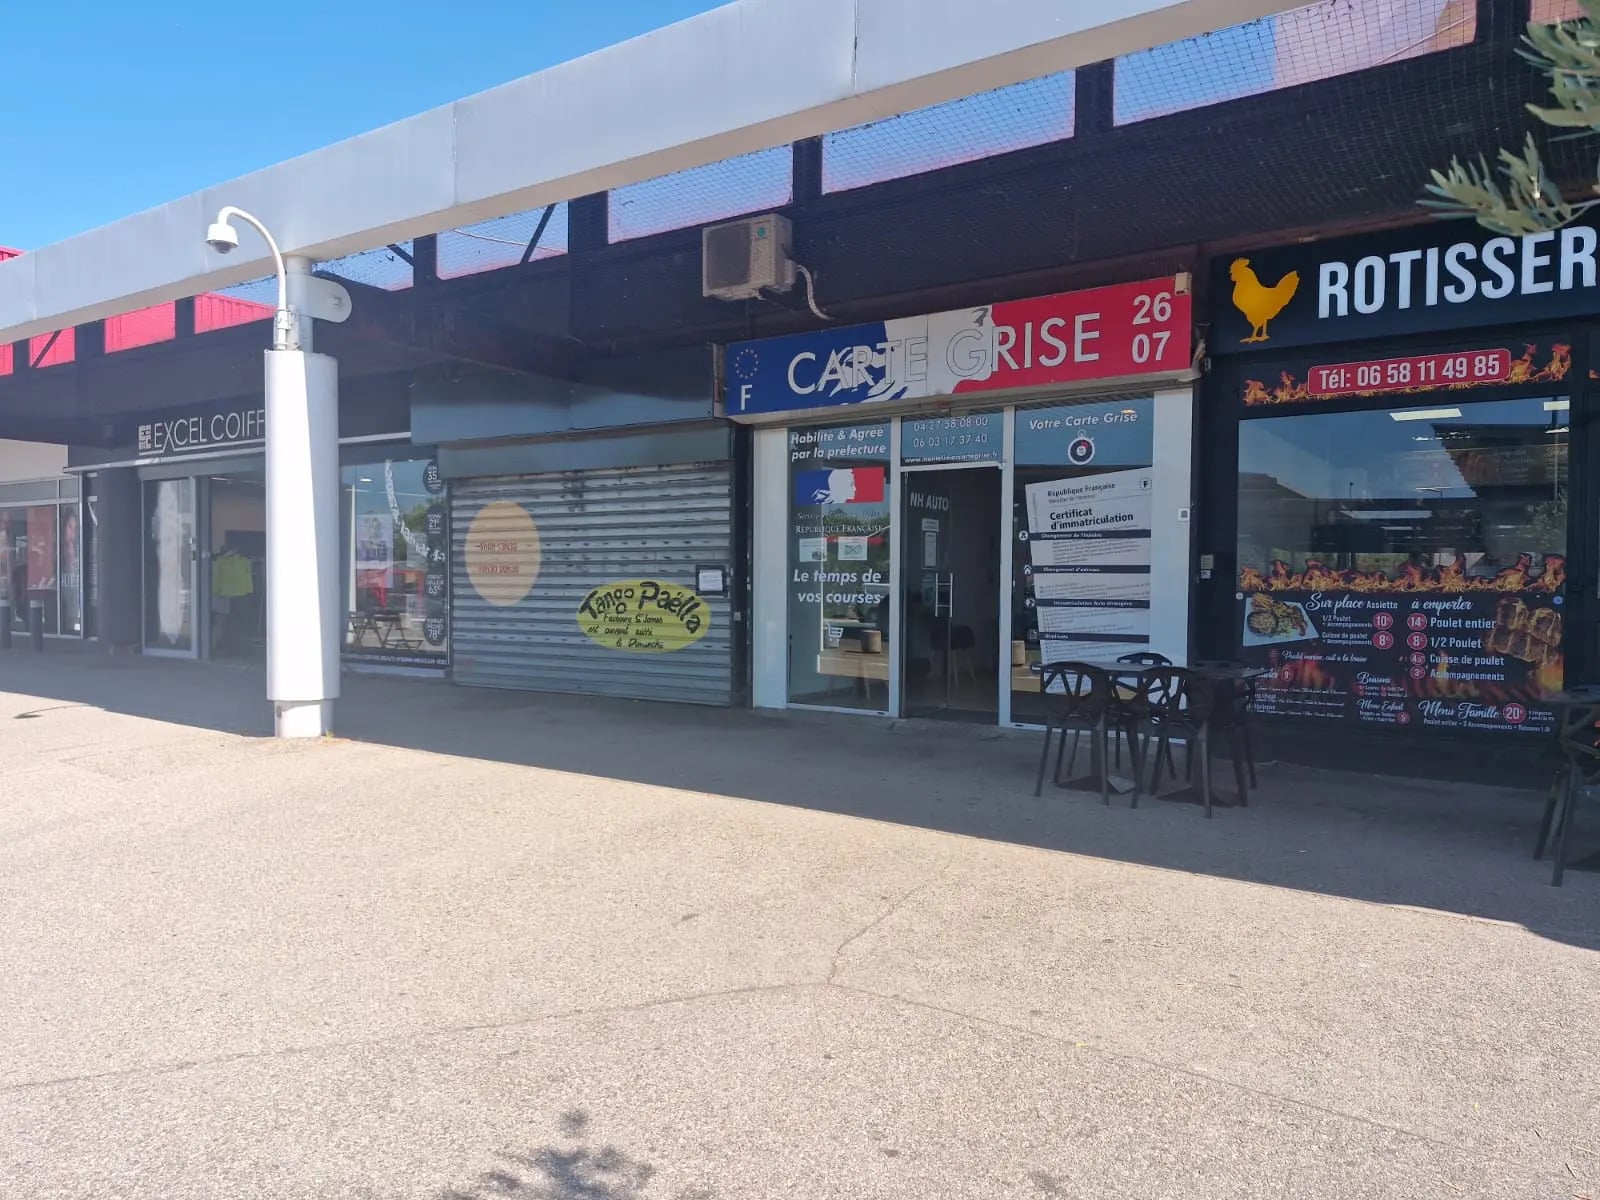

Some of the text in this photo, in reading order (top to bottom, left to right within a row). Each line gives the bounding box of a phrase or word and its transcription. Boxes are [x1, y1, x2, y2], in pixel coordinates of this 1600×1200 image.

[1132, 292, 1172, 325] 26
[787, 312, 1101, 396] CARTE GRISE
[1131, 331, 1172, 363] 07
[1319, 354, 1500, 390] Tél: 06 58 11 49 85
[740, 384, 754, 411] F
[913, 422, 926, 432] 04
[975, 416, 989, 426] 00
[1030, 412, 1138, 431] Votre Carte Grise
[154, 416, 208, 450] EXCEL
[791, 428, 834, 445] Habilité
[837, 430, 847, 441] &
[913, 438, 925, 448] 06
[928, 436, 940, 447] 03
[959, 434, 971, 445] 37
[974, 433, 988, 443] 40
[791, 450, 812, 462] par
[814, 447, 825, 459] la
[910, 491, 950, 511] NH AUTO
[1050, 507, 1093, 520] Certificat
[1050, 512, 1135, 530] d'immatriculation
[793, 568, 882, 587] Le temps de
[578, 588, 635, 619] Tango
[797, 592, 881, 604] vos courses
[1305, 592, 1398, 615] Sur place Assiette
[1422, 595, 1473, 617] emporter
[1430, 617, 1497, 629] Poulet entier
[1429, 637, 1482, 649] 1/2 Poulet
[1430, 654, 1505, 667] Cuisse de poulet
[1430, 669, 1505, 682] Accompagnements
[1418, 700, 1499, 720] Menu Famille
